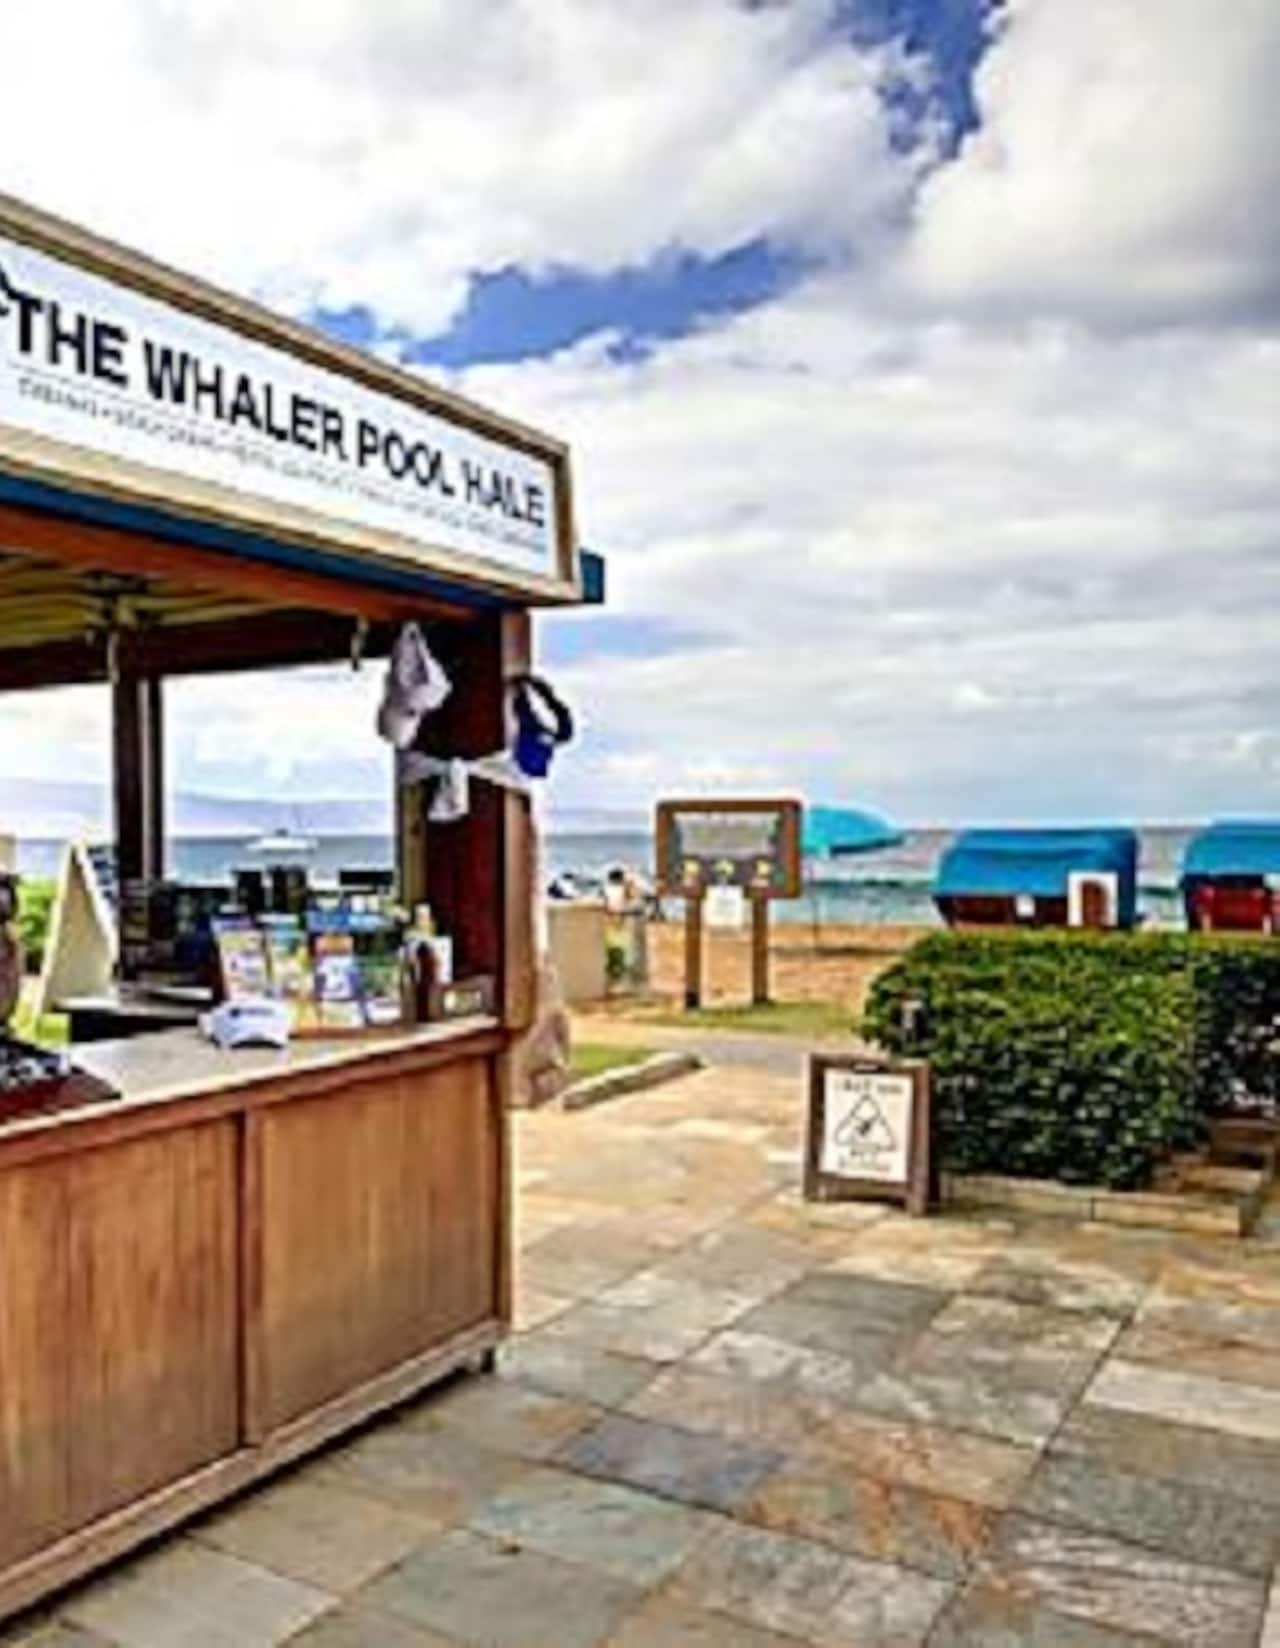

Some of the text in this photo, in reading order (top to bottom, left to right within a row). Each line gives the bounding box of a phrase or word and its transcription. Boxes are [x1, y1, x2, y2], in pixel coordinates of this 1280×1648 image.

[10, 290, 128, 388] THE
[142, 338, 348, 462] WHALER
[357, 418, 456, 497] POOL
[461, 459, 545, 528] HALE
